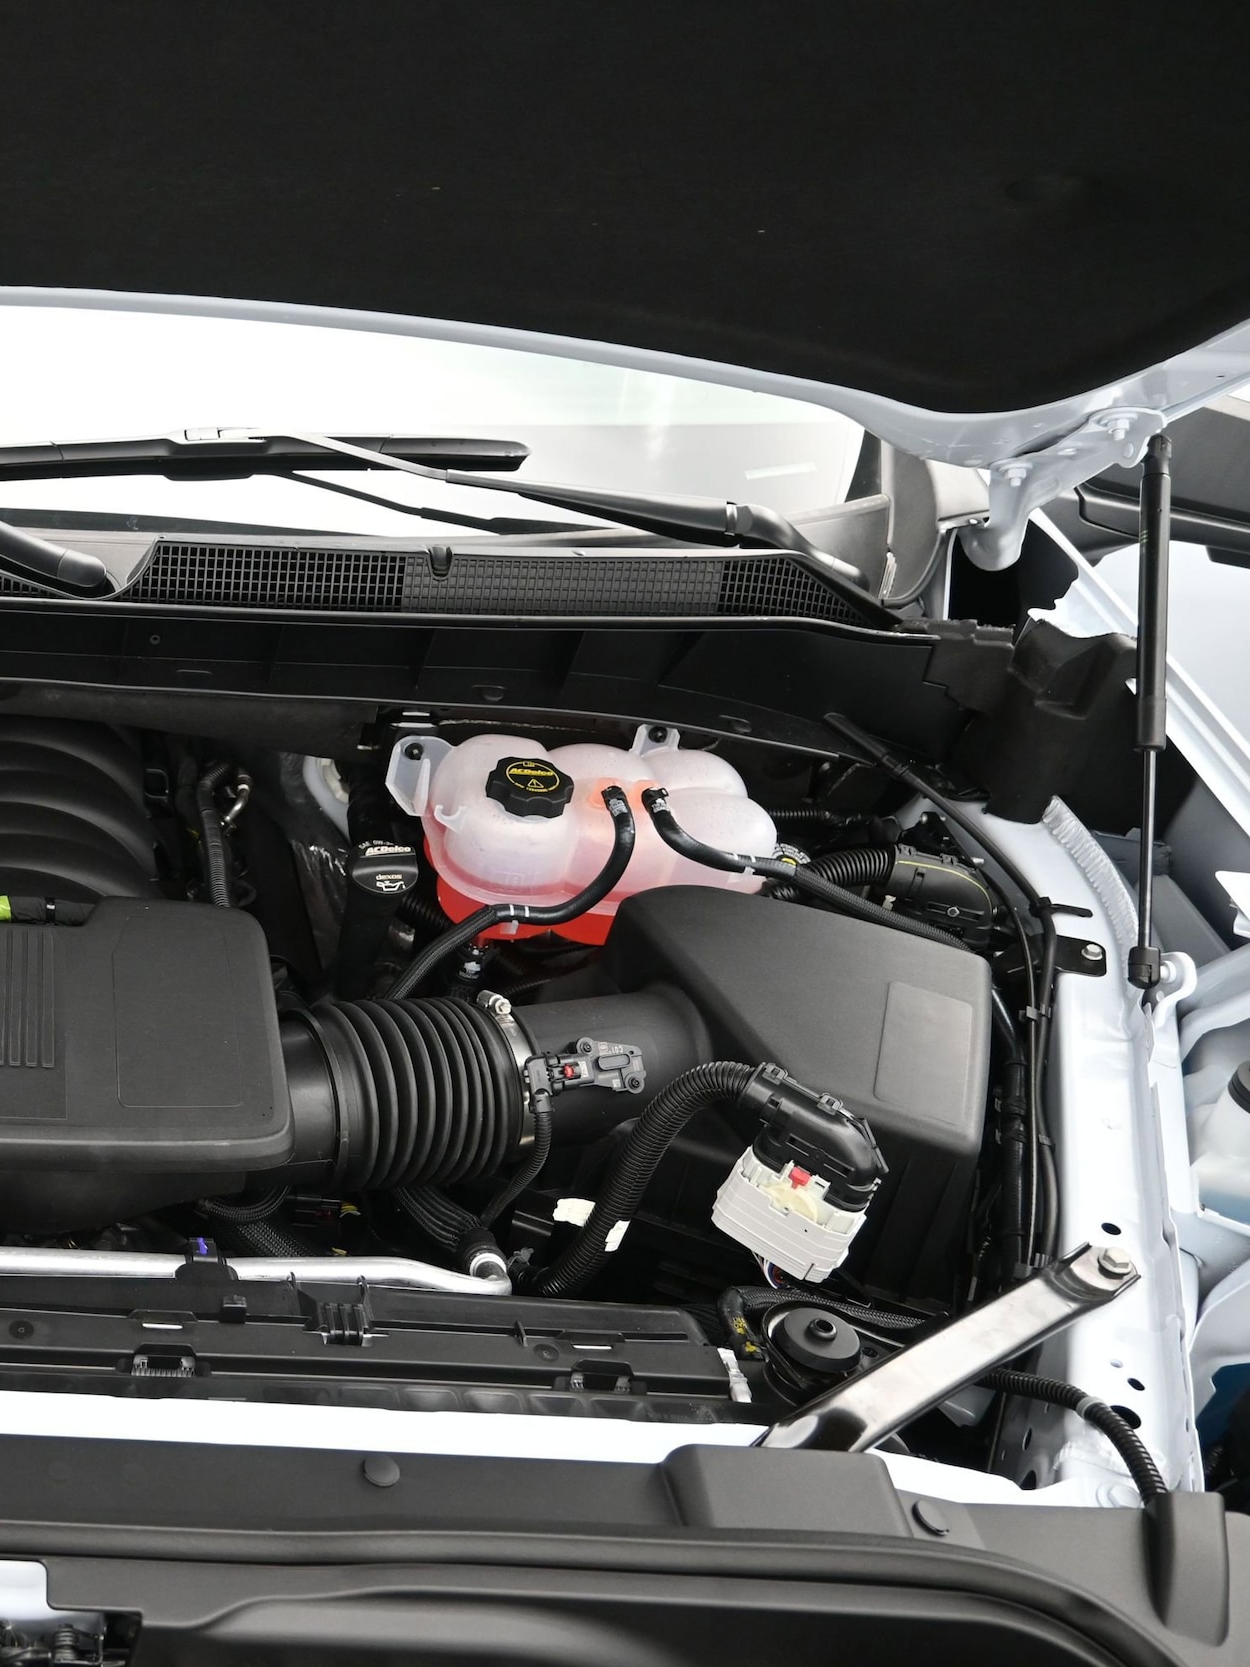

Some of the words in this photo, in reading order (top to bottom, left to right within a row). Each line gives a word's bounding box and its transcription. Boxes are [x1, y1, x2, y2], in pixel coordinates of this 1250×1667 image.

[508, 768, 554, 777] ACDelco
[365, 845, 411, 857] ACDelco
[375, 873, 403, 881] dexos
